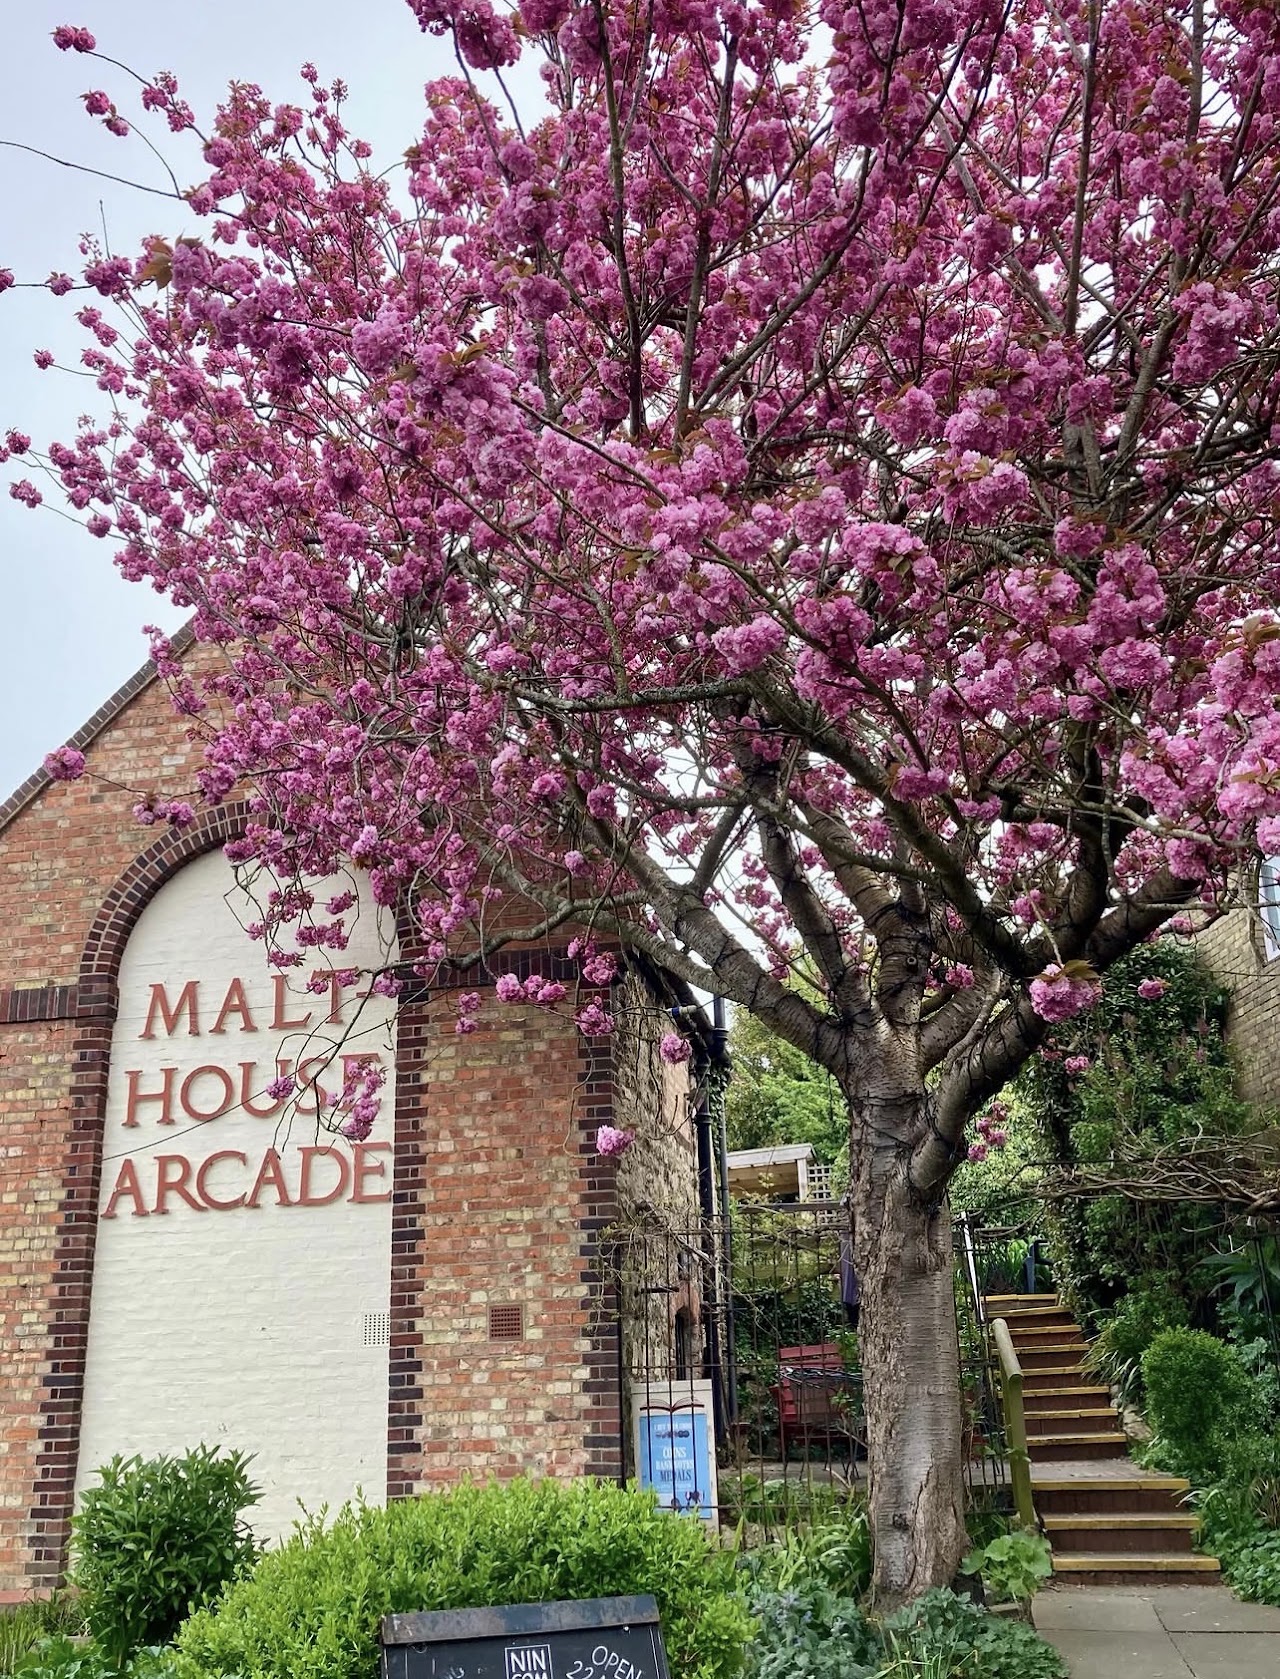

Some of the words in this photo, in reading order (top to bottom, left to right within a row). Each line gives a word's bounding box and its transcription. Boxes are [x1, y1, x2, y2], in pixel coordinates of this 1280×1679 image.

[121, 1052, 382, 1128] HOUSE
[101, 1141, 393, 1218] ARCADE
[510, 1649, 546, 1673] NIN
[592, 1645, 642, 1679] OPEN
